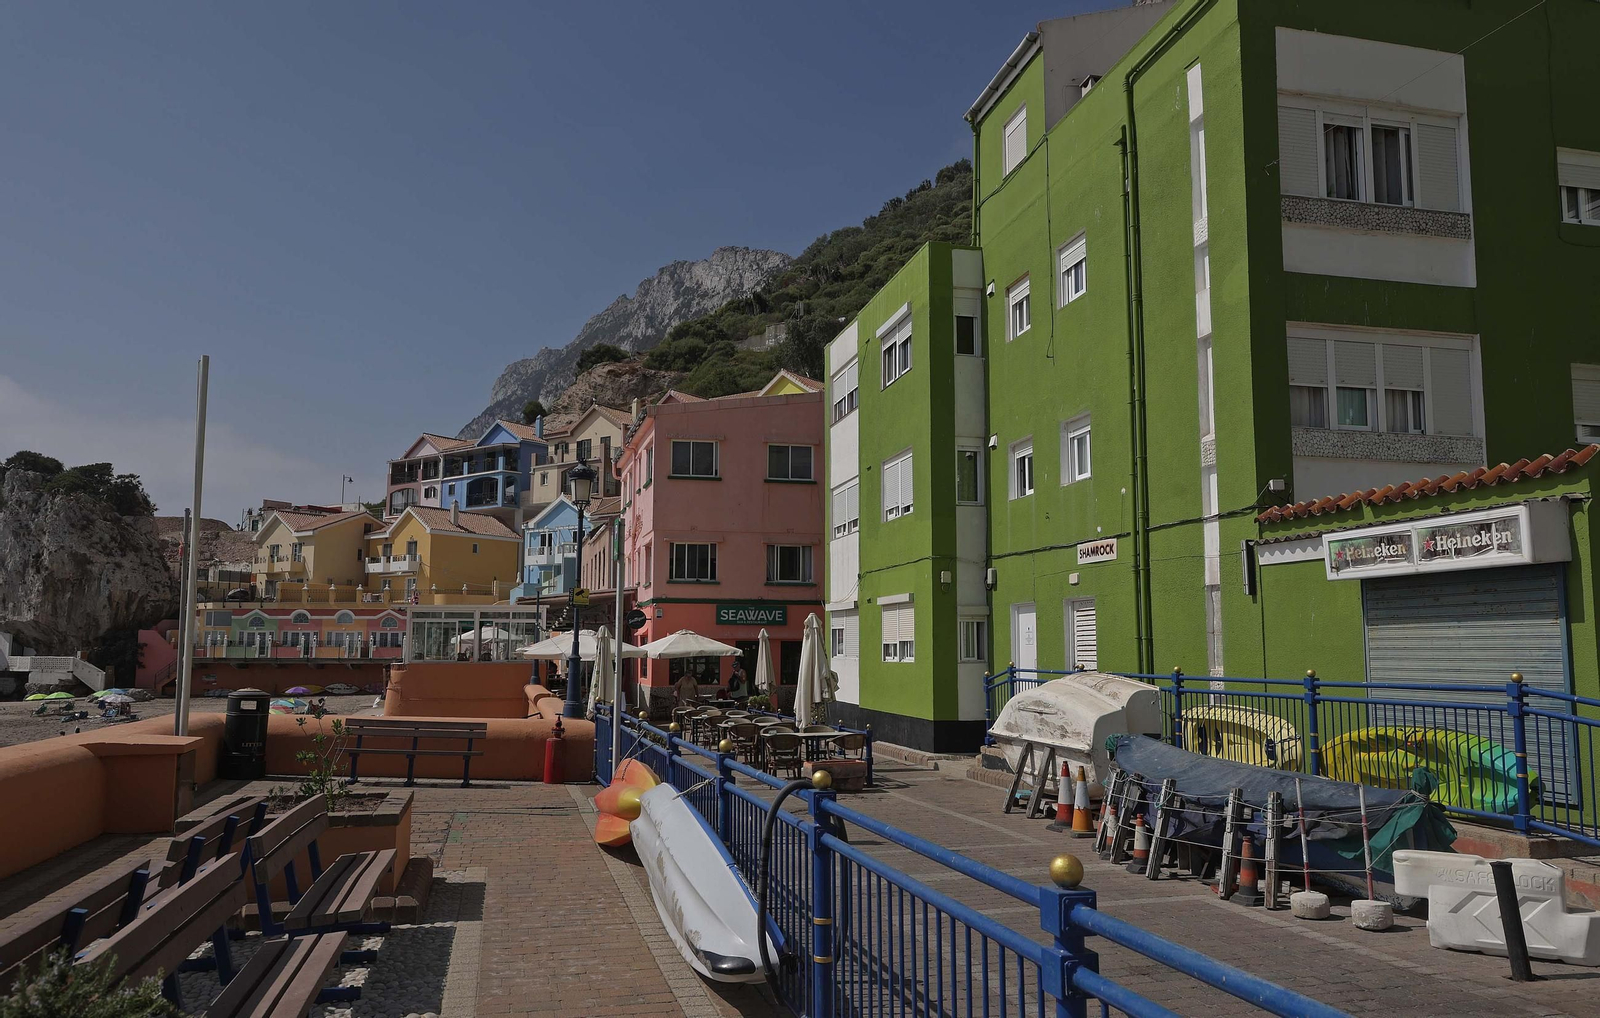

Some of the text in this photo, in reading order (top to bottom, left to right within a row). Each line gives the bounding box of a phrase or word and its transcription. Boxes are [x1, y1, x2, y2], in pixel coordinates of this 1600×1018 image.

[1435, 529, 1513, 551] Heineken
[1079, 543, 1115, 559] SHAMROCK
[1346, 543, 1407, 560] Heineken
[720, 609, 783, 621] SEAWAVE
